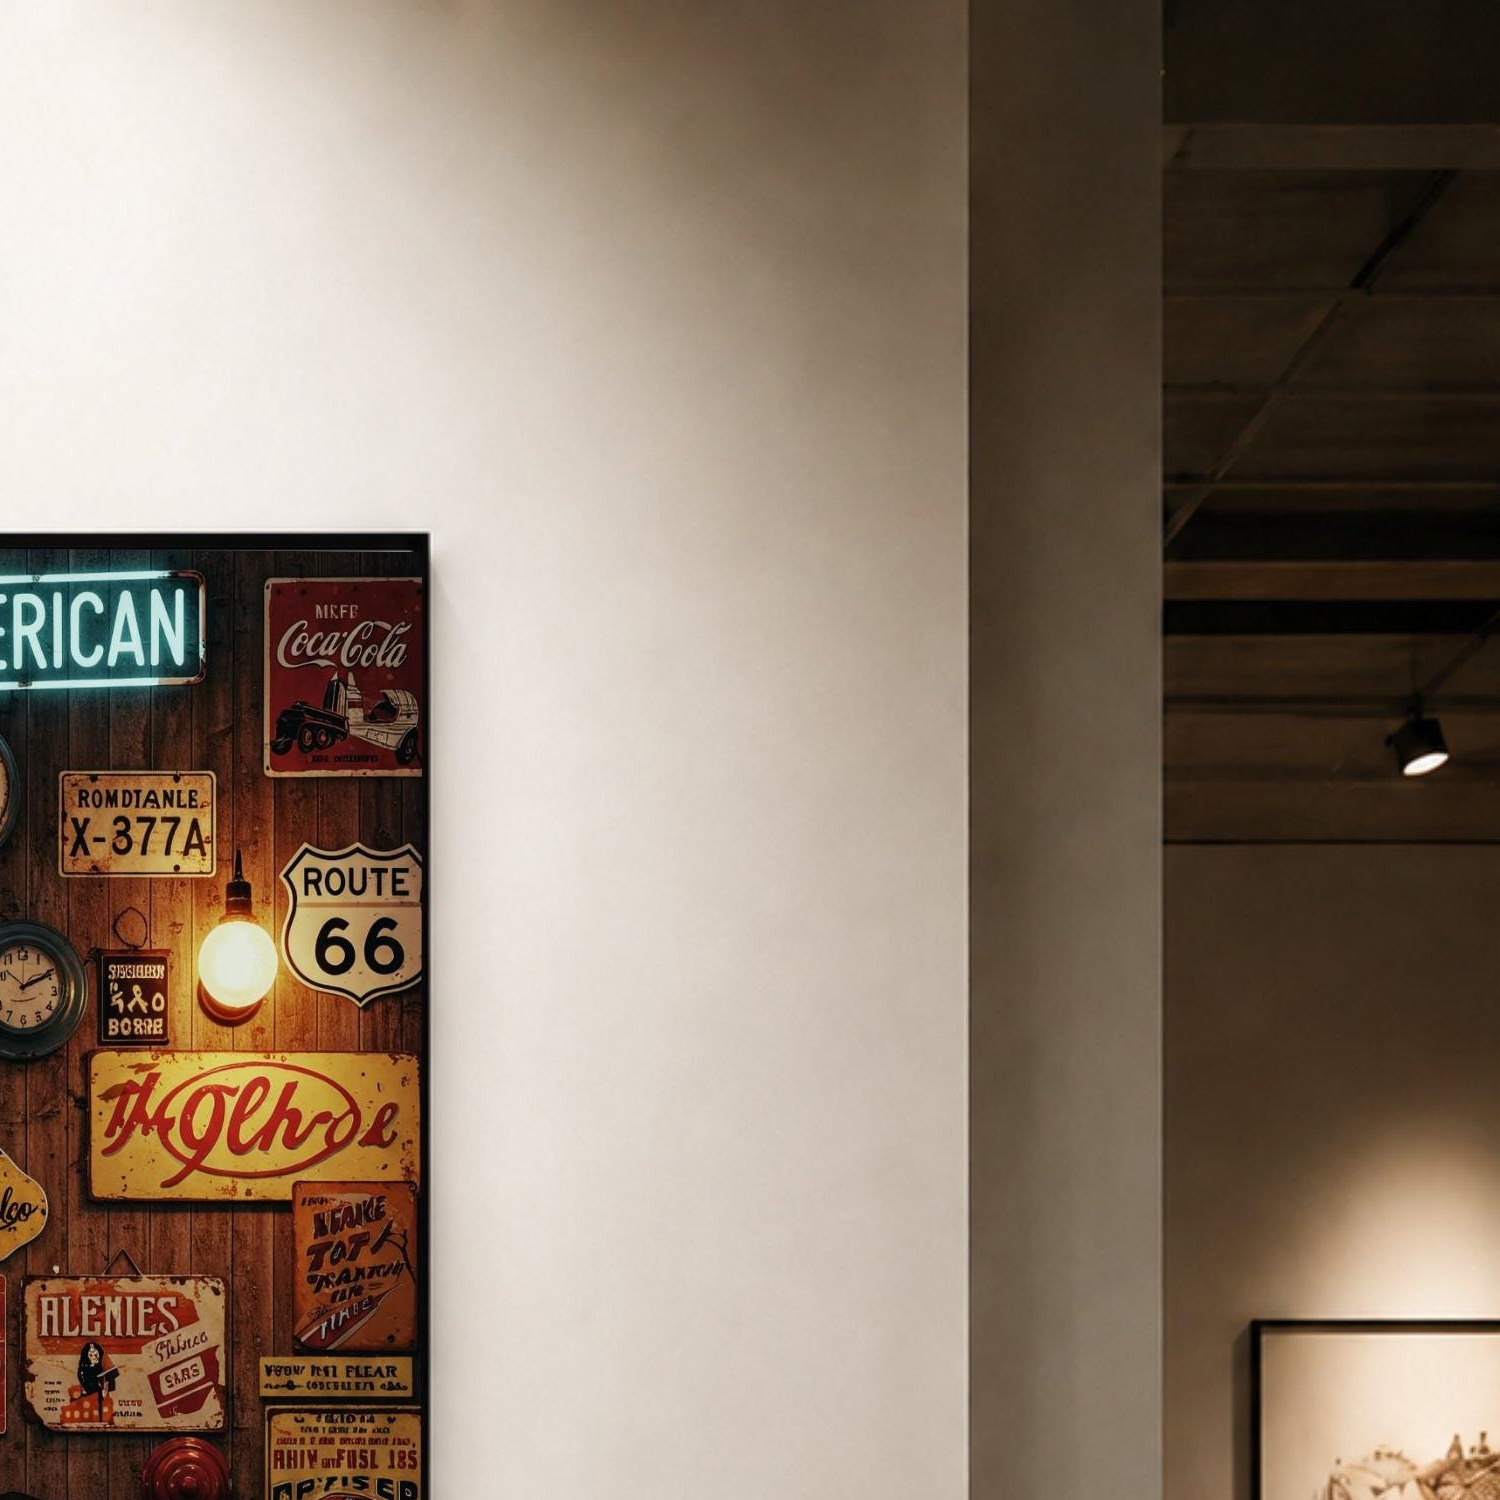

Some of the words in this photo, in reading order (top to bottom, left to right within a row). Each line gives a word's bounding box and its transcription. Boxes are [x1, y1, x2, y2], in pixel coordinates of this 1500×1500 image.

[69, 816, 207, 857] X-377A
[302, 867, 410, 897] ROUTE
[315, 917, 405, 976] 66
